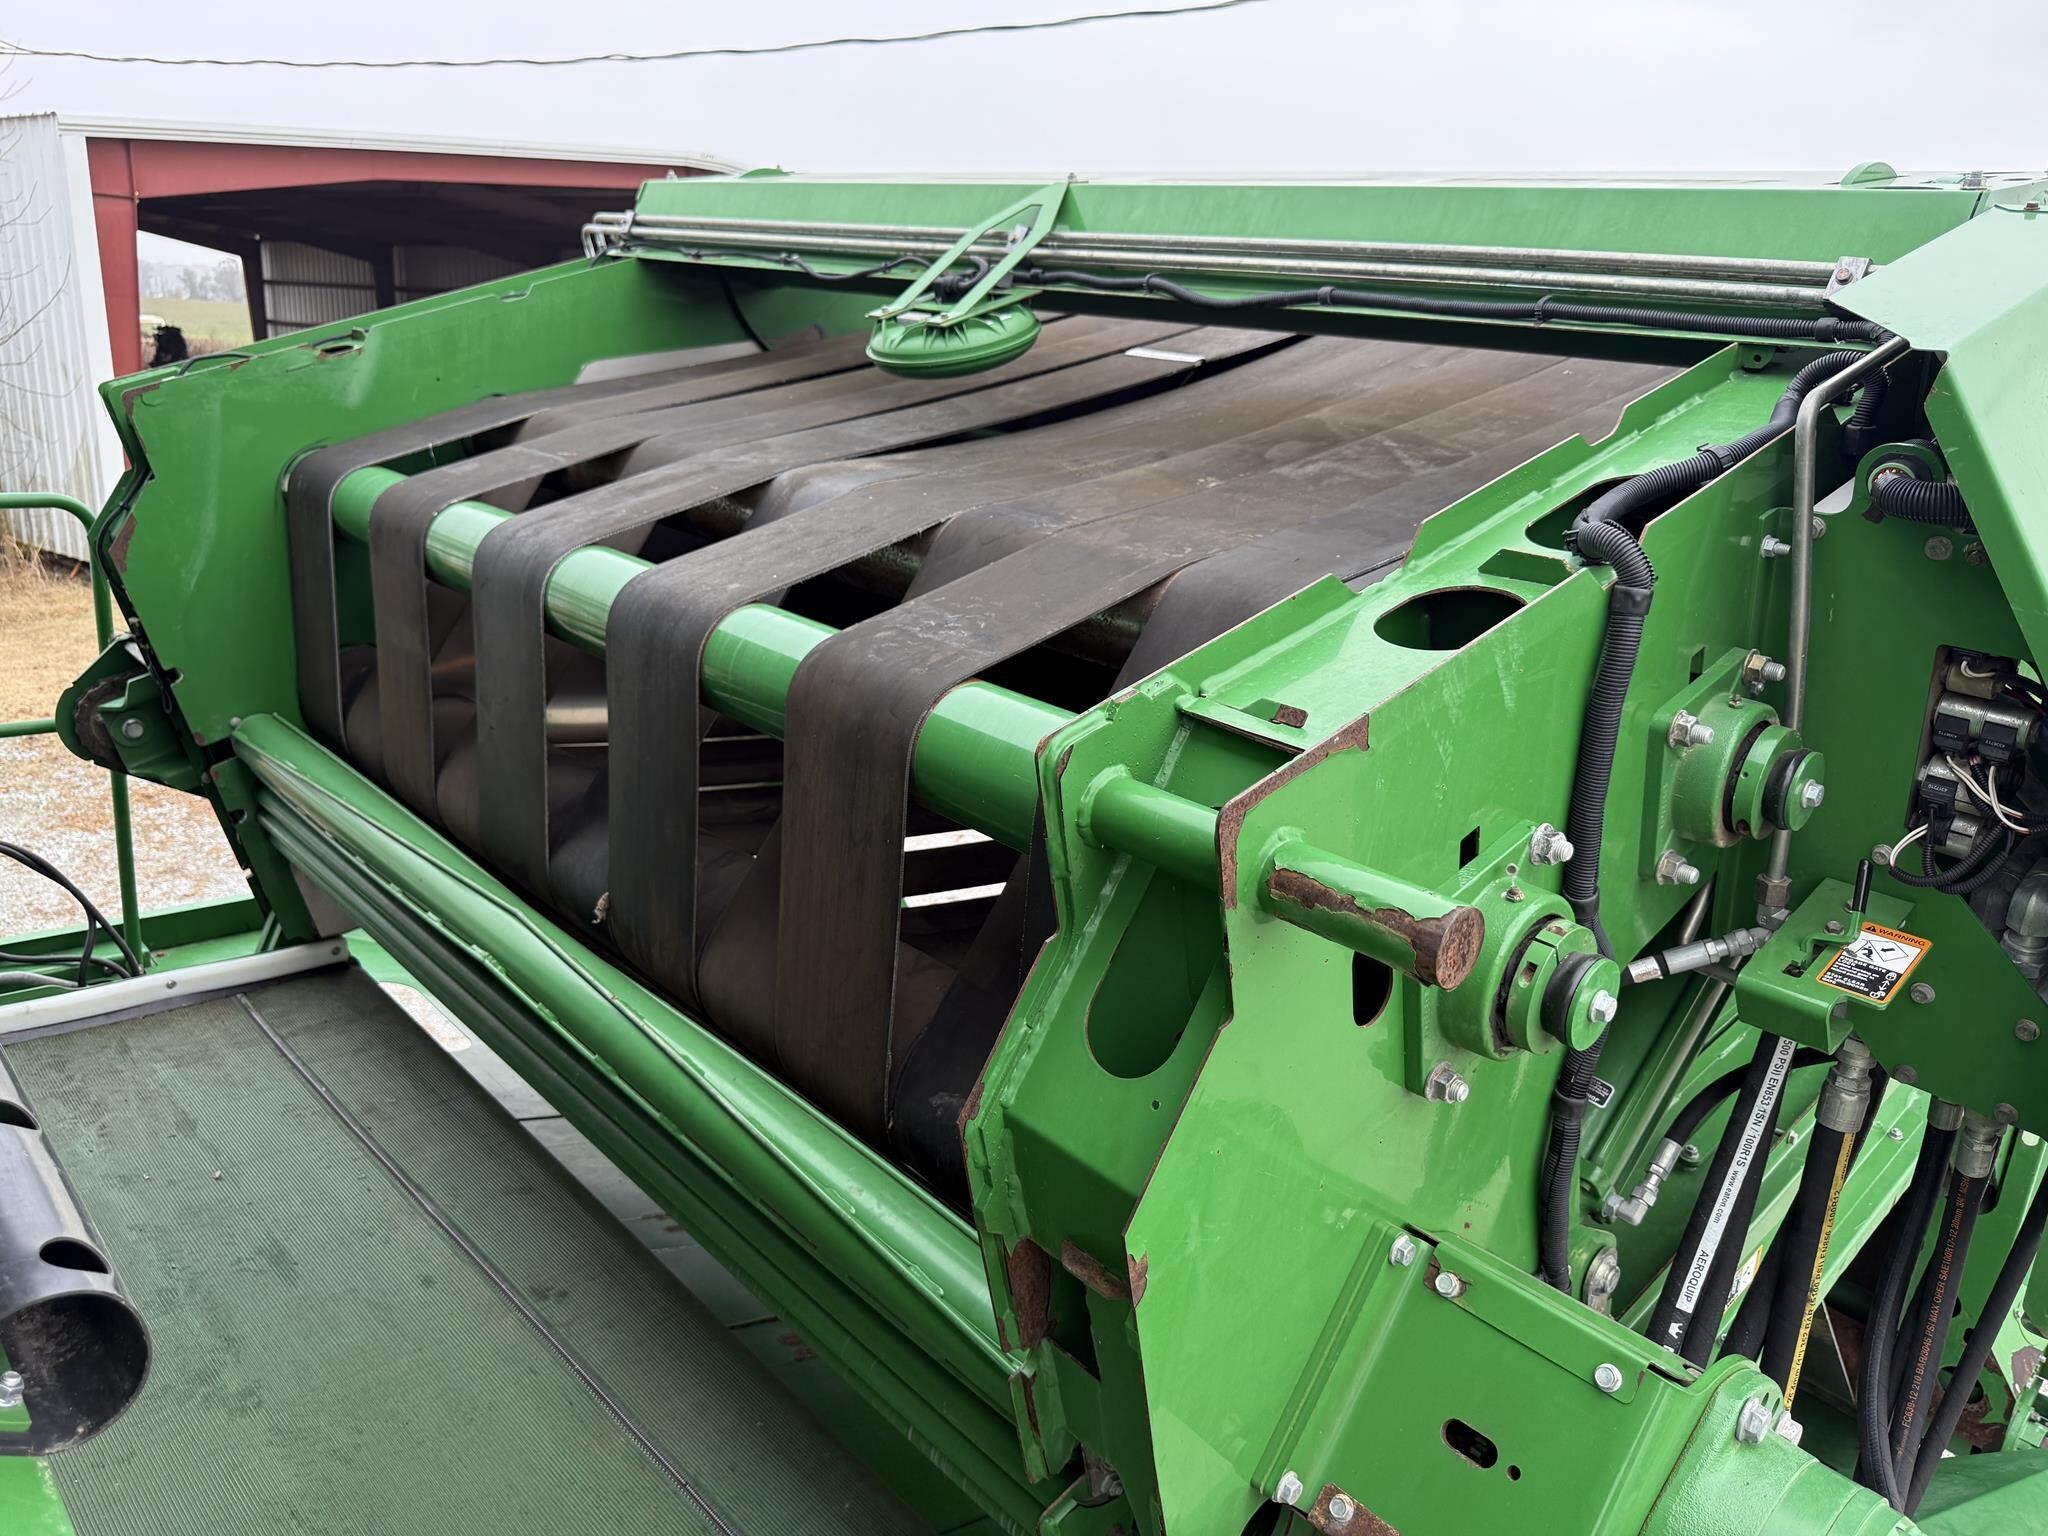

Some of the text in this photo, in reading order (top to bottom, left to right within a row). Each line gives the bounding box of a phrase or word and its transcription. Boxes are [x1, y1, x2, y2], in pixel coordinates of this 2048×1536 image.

[1878, 928, 1926, 947] WARNING
[1780, 1039, 1793, 1056] 500
[1770, 1057, 1787, 1077] PSI)
[1760, 1077, 1779, 1107] EN853
[1752, 1107, 1766, 1130] 1SN
[1736, 1133, 1757, 1168] 100R1S
[1713, 1170, 1740, 1225] www.eaton.com
[1684, 1249, 1710, 1303] AEROQUIP
[1933, 1281, 1945, 1304] OPER
[1929, 1304, 1940, 1322] MAX
[1925, 1321, 1936, 1337] PSI
[1915, 1337, 1932, 1375] BAR/3045
[1911, 1375, 1922, 1391] 210
[1902, 1390, 1919, 1428] FC639-12
